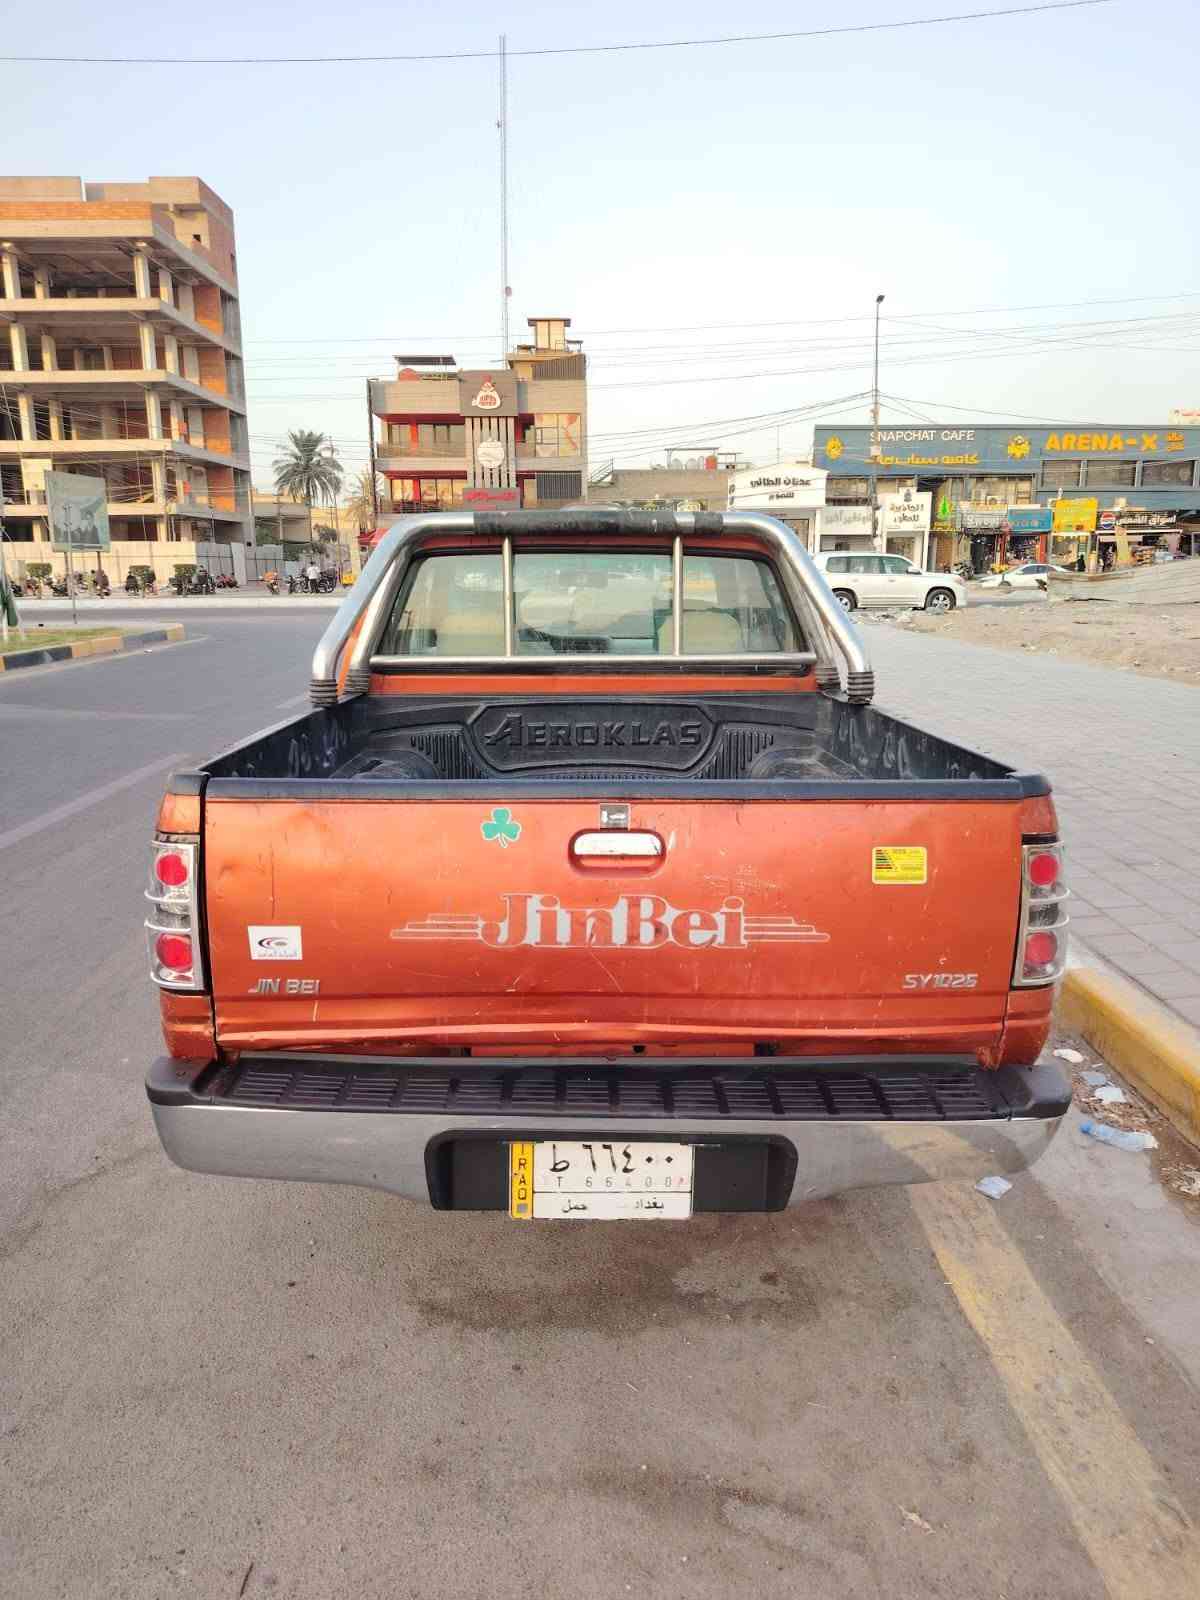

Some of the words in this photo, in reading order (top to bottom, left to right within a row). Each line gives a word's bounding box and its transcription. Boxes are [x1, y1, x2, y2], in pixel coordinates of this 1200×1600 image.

[870, 430, 937, 441] SNAPCHAT
[941, 430, 976, 441] CAFE
[1045, 432, 1158, 451] ARENA-X
[484, 712, 702, 747] AEROKLAS
[478, 893, 748, 949] JinBei
[248, 978, 281, 994] JIN
[286, 979, 320, 995] BEI
[634, 1197, 665, 1213] بغداد
